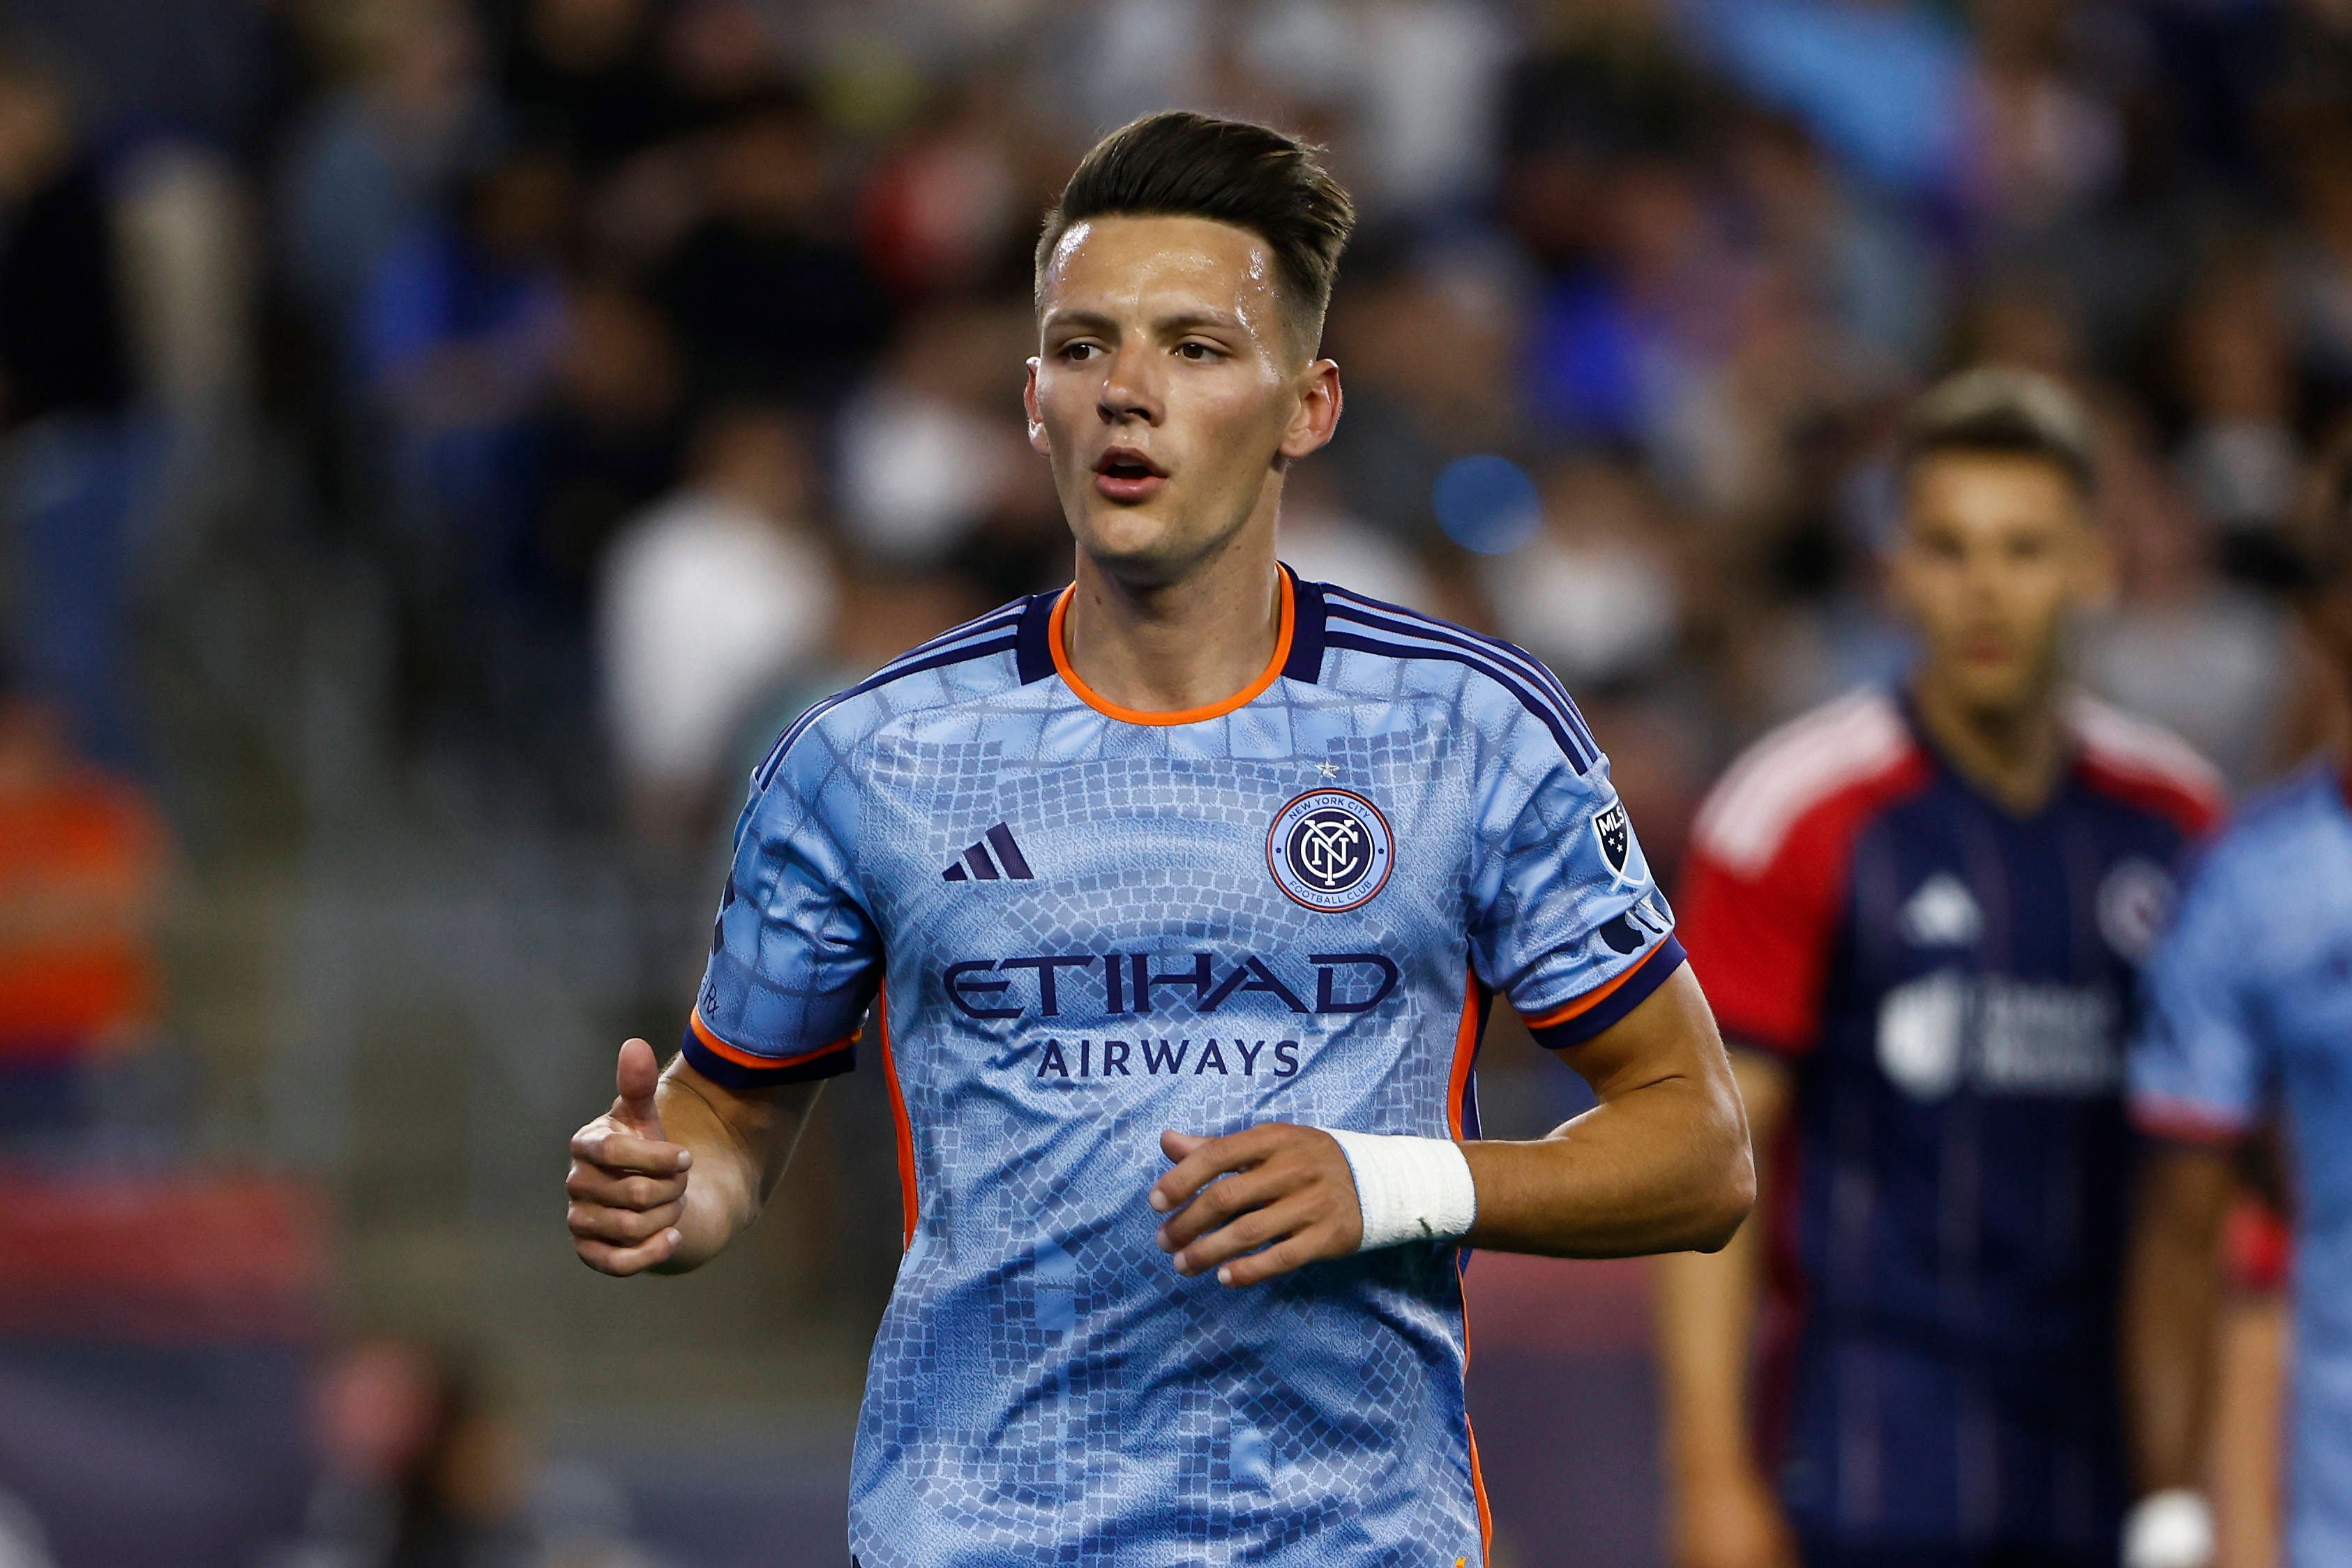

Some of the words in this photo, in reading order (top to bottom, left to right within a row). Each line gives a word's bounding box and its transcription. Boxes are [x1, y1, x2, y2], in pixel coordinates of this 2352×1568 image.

[1289, 801, 1311, 820] NEW
[1315, 797, 1345, 806] YORK
[1348, 801, 1371, 819] CITY
[1598, 806, 1624, 836] MLS
[1288, 880, 1344, 904] FOOTBALL
[1347, 880, 1373, 900] CLUB
[943, 952, 1399, 1019] ETIHAD
[1036, 1039, 1300, 1078] AIRWAYS
